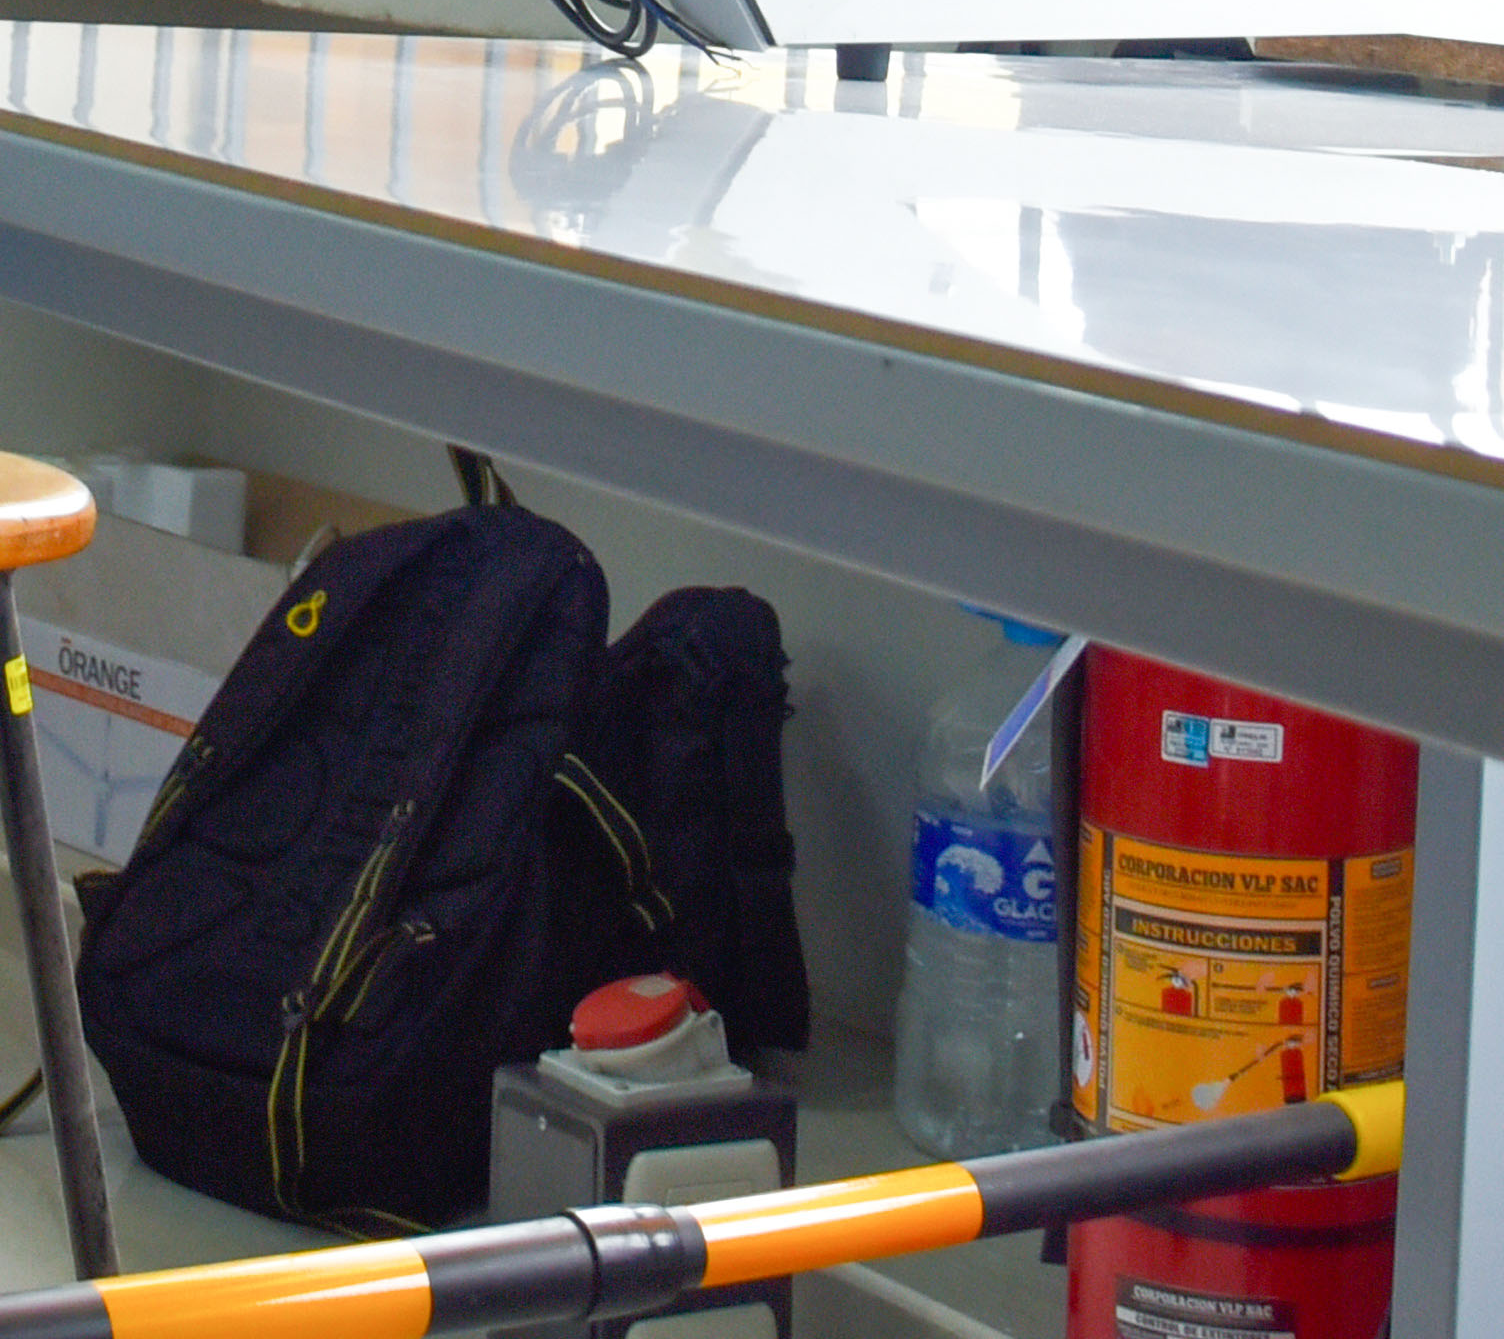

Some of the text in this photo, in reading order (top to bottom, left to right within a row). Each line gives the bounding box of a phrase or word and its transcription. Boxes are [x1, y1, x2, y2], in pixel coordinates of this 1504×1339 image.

[1118, 853, 1235, 890] CORPORACION
[1282, 875, 1319, 894] SAC
[1132, 918, 1297, 953] INSTRUCCIONES
[1329, 896, 1341, 950] POLVO
[1327, 954, 1341, 1032] QUIMICO
